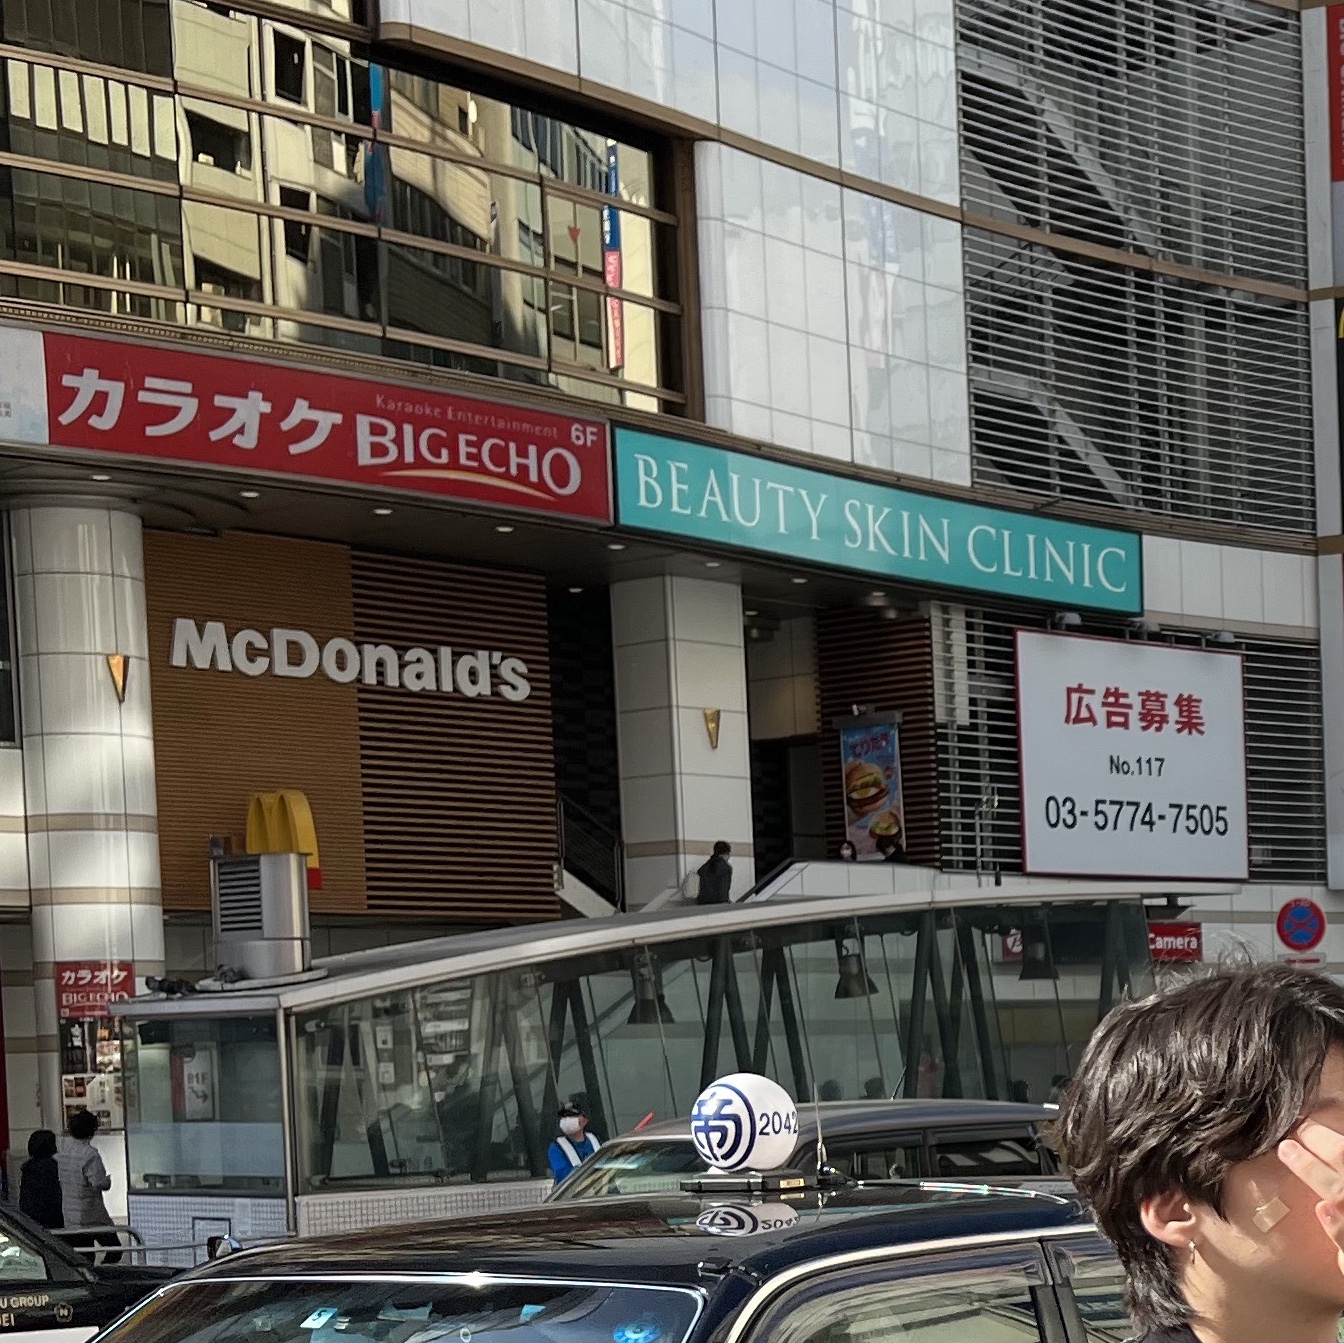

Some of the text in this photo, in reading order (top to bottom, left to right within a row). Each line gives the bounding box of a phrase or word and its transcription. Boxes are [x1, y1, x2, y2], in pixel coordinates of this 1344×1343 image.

[57, 366, 344, 456] カラオケ
[375, 394, 559, 439] Karaoke Entertainment
[356, 412, 582, 497] BIG ECHO
[570, 422, 598, 448] 6F
[633, 453, 1128, 595] BEAUTY SKIN CLINIC
[169, 617, 533, 702] McDonald's
[1064, 683, 1206, 736] 広告募集
[1109, 755, 1166, 777] No.117
[1045, 795, 1229, 836] 03-5774-7505
[61, 968, 128, 986] カラオケ
[61, 992, 88, 1005] BIG
[10, 1294, 49, 1309] GROUP
